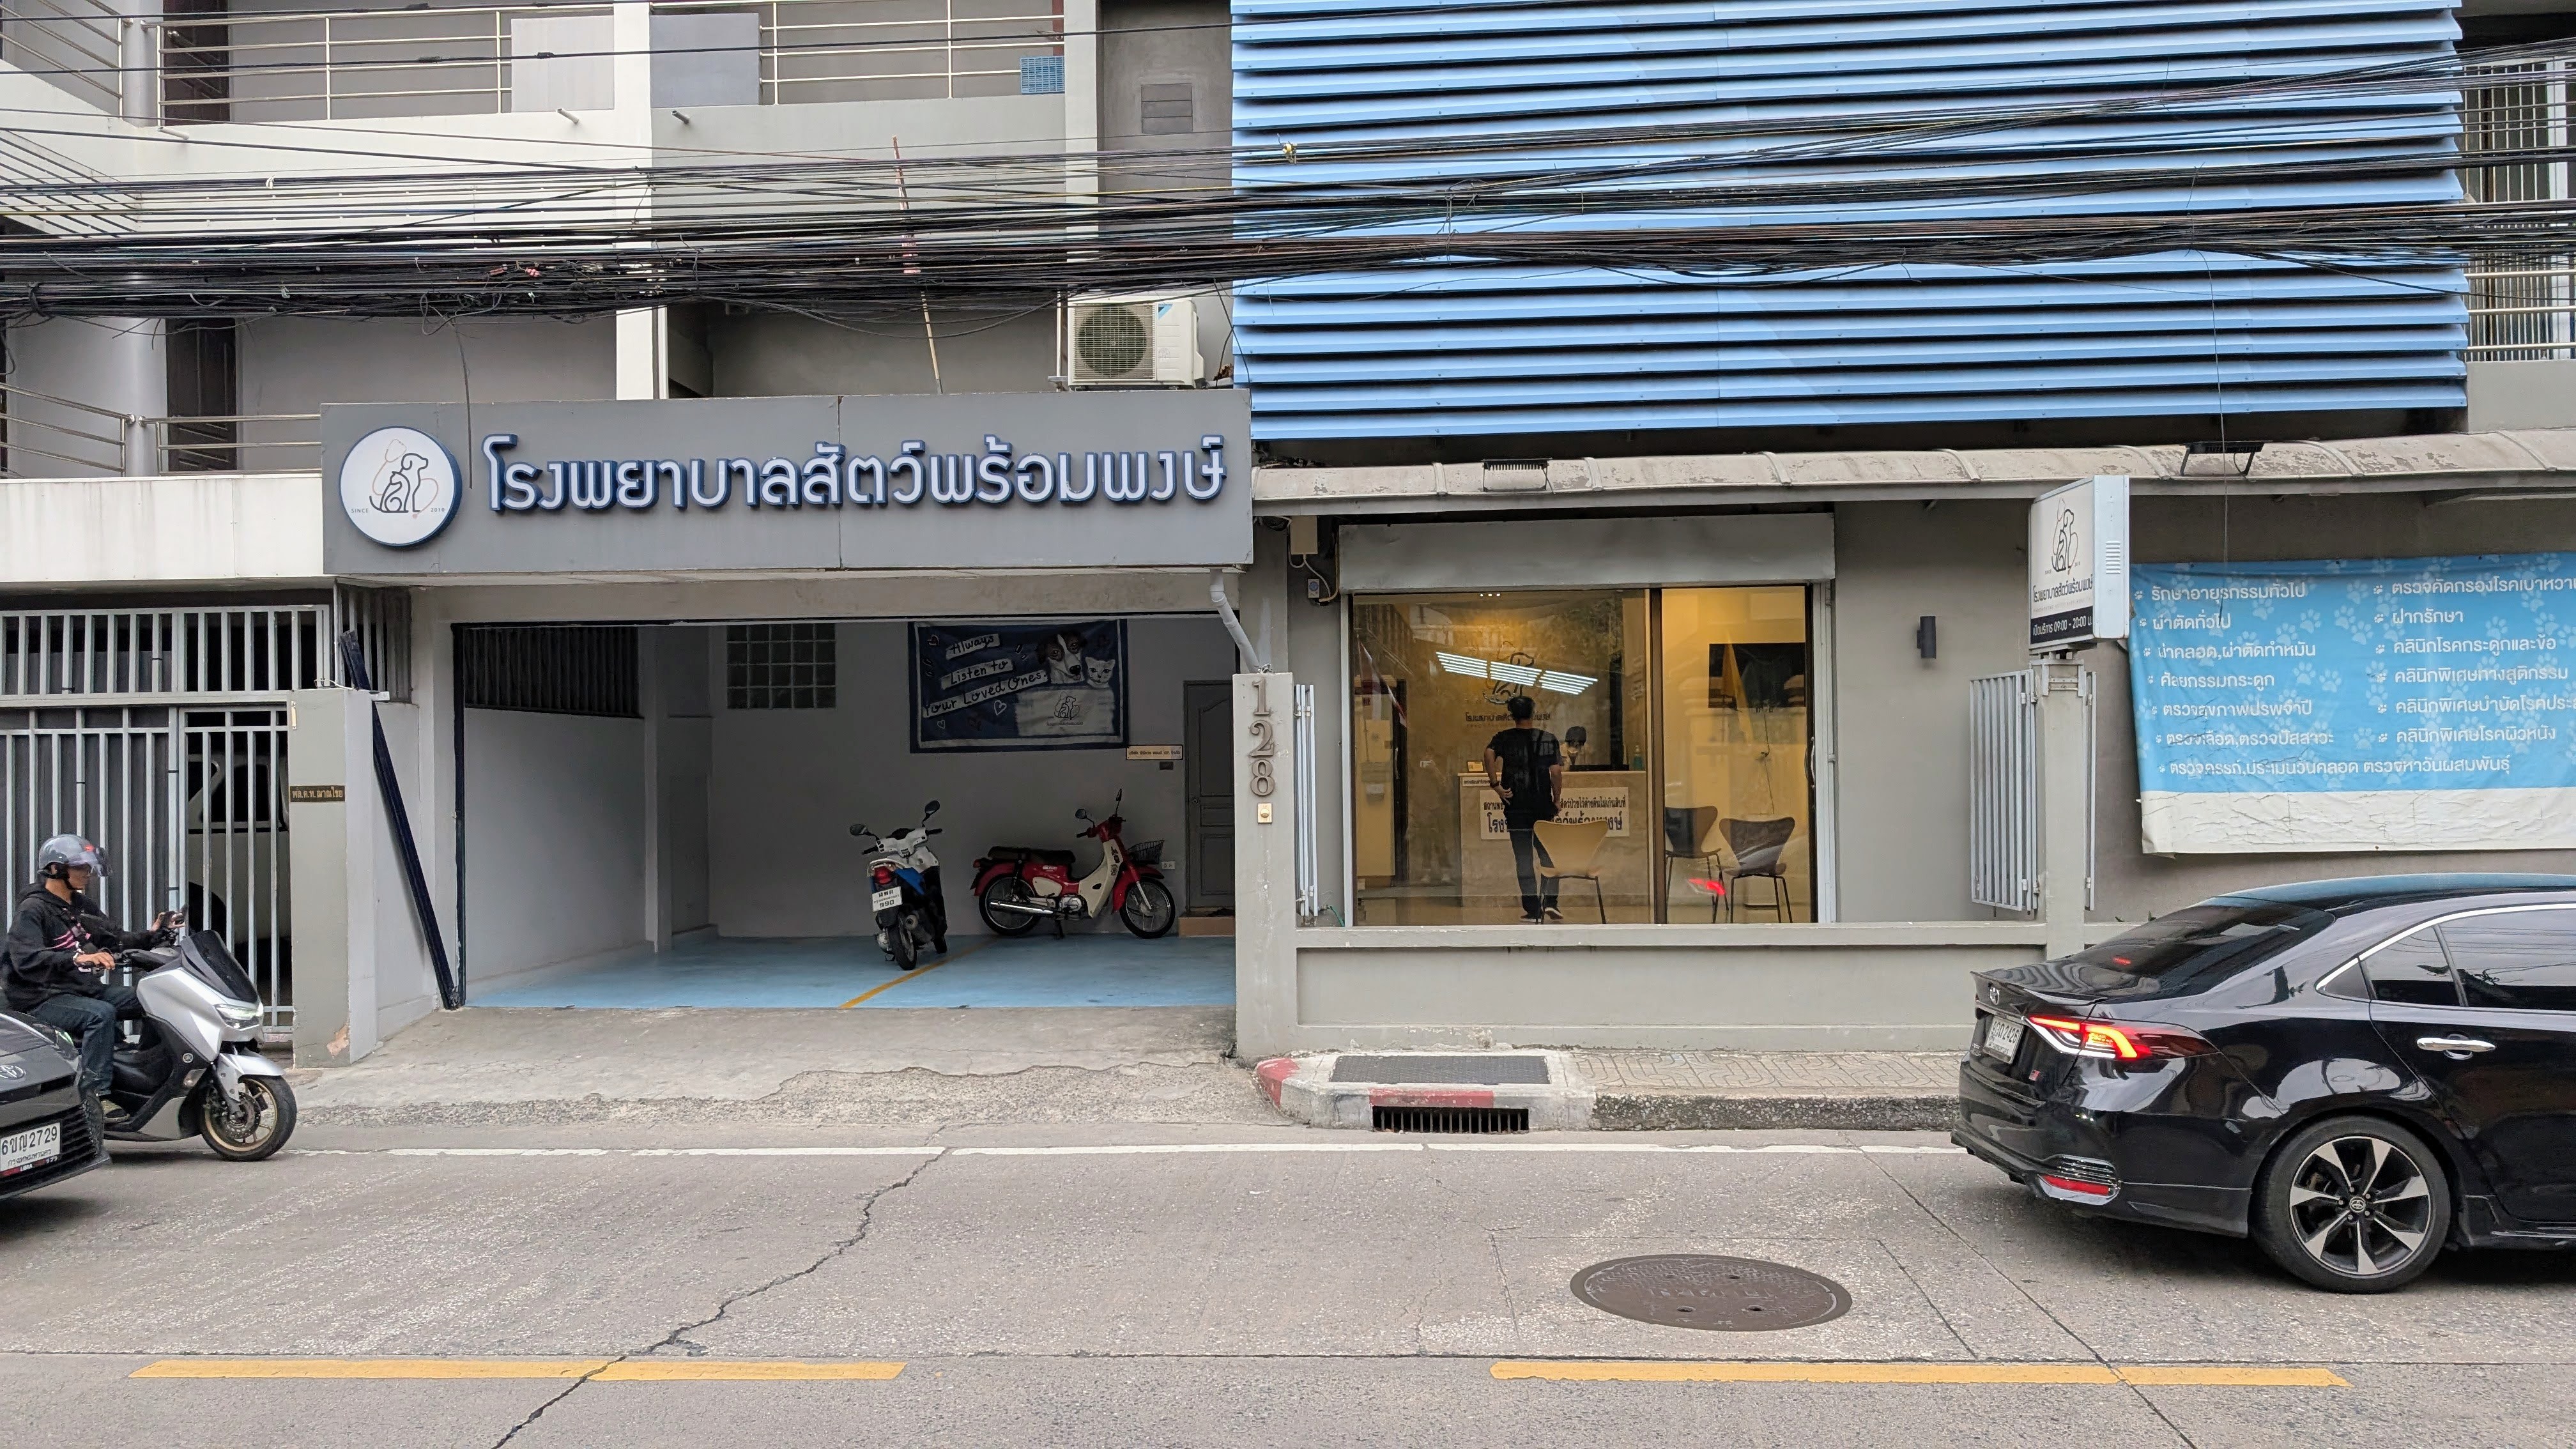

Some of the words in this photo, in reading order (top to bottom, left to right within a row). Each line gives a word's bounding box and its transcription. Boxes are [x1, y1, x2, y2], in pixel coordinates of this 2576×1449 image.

[480, 433, 1227, 513] โรงพยาบาลสัตว์พร้อมพงษ์
[2033, 573, 2093, 602] โรงพยาบาลสัตว์พร้อมพงษ์
[2151, 579, 2306, 604] รักษาอายุรกรรมทั่วไป
[2053, 618, 2067, 632] 09:00
[2073, 615, 2087, 629] 20:00
[2153, 609, 2232, 631] ผ่าตัดทั่วไป
[2393, 608, 2463, 624] ฝากรักษา
[952, 634, 995, 654] Always
[2158, 641, 2316, 661] ผ่าคลอด,ผ่าตัดทำหมัน
[2394, 633, 2556, 656] คลินิกโรคกระดูกและข้อ
[951, 666, 988, 686] Listen
[991, 660, 1009, 673] to
[2161, 671, 2274, 691] ศัลยกรรมกระดูก
[2395, 665, 2568, 685] คลินิกพิเศษทางสูติกรรม
[923, 698, 957, 717] Your
[963, 680, 1006, 705] Loved
[1249, 678, 1275, 797] 128
[2166, 728, 2334, 747] ตรวจเลือด,ตรวจปัสสาวะ
[2396, 724, 2556, 743] คลินิกพิเศษโรคผิวหนัง
[2170, 760, 2359, 777] ตรวจครรภ์,ประเมนวนคลอด
[2363, 754, 2511, 775] ตรวจหาวันผสมพันธุ์
